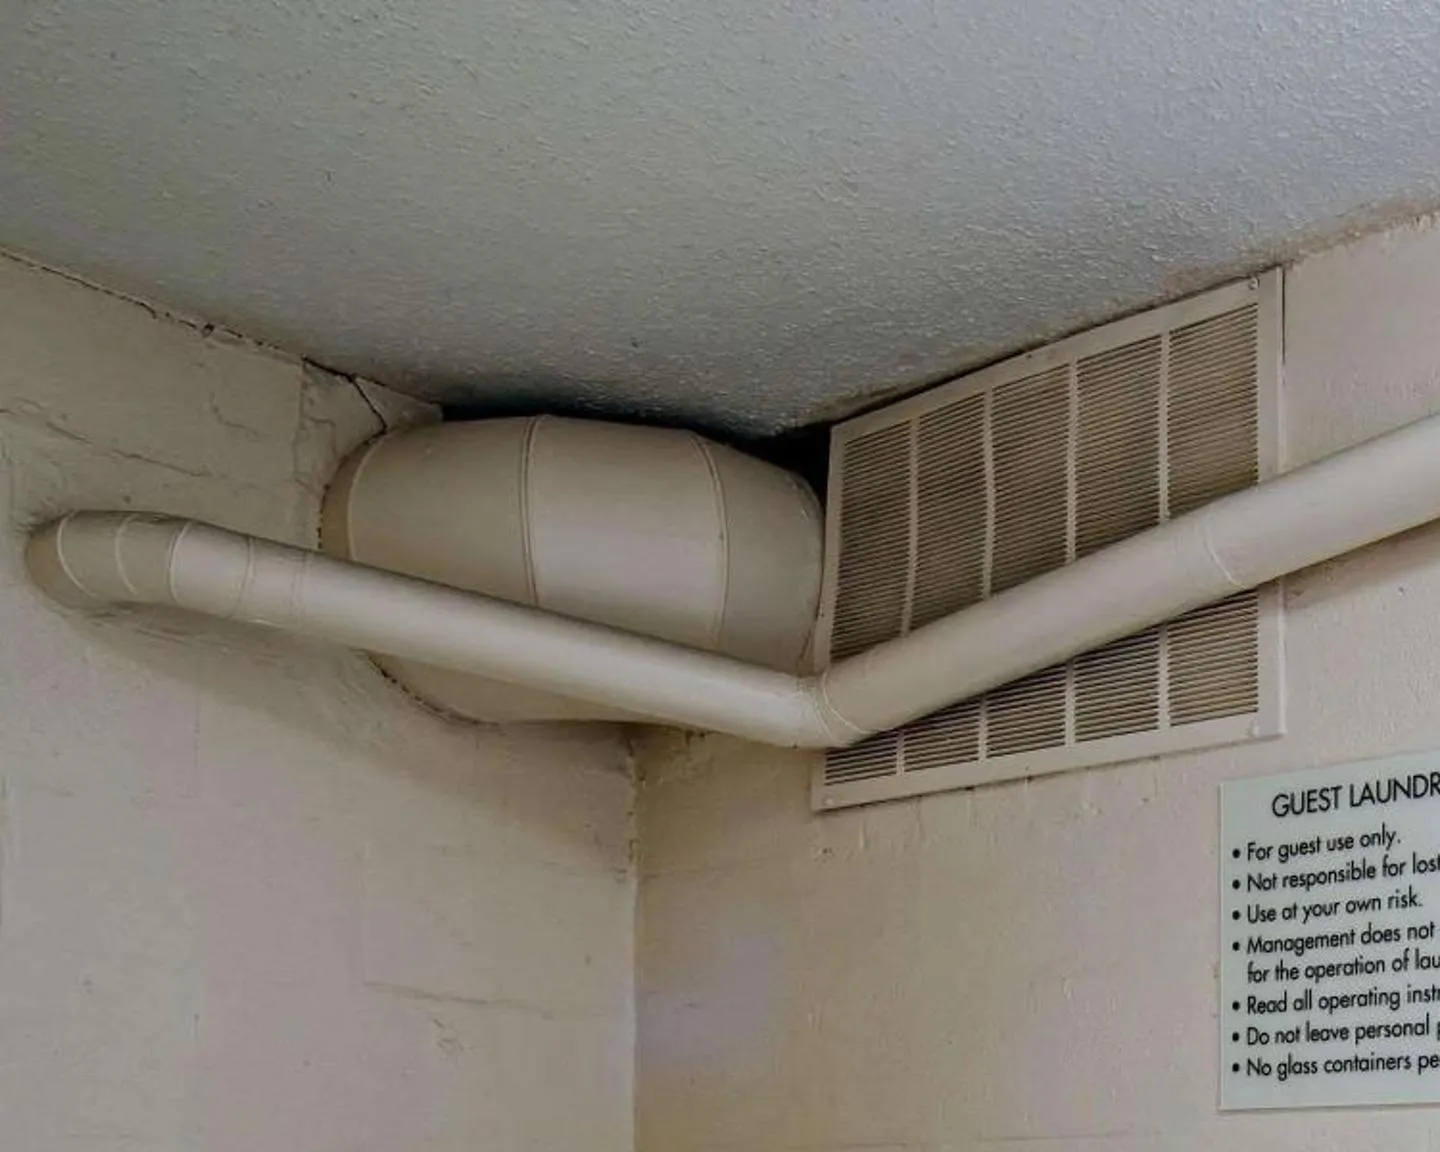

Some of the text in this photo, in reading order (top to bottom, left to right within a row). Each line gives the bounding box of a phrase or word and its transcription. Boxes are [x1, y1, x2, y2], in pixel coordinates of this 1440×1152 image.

[1272, 786, 1341, 817] GUEST
[1247, 824, 1401, 863] For guest use only.
[1247, 873, 1278, 891] Not
[1282, 858, 1377, 891] responsible
[1382, 855, 1405, 877] for
[1247, 889, 1422, 923] Use at your own risk.
[1247, 928, 1355, 956] Management
[1361, 922, 1400, 944] does
[1407, 921, 1435, 939] not
[1247, 963, 1270, 984] for
[1275, 958, 1300, 980] the
[1305, 954, 1385, 983] operation
[1391, 953, 1411, 971] of
[1247, 996, 1288, 1015] Read
[1293, 992, 1313, 1012] all
[1318, 986, 1400, 1014] operating
[1247, 1028, 1271, 1045] Do
[1274, 1025, 1302, 1043] not
[1306, 1020, 1349, 1042] leave
[1355, 1014, 1430, 1044] personal
[1247, 1059, 1272, 1077] No
[1277, 1052, 1318, 1080] glass
[1323, 1050, 1411, 1072] containers
